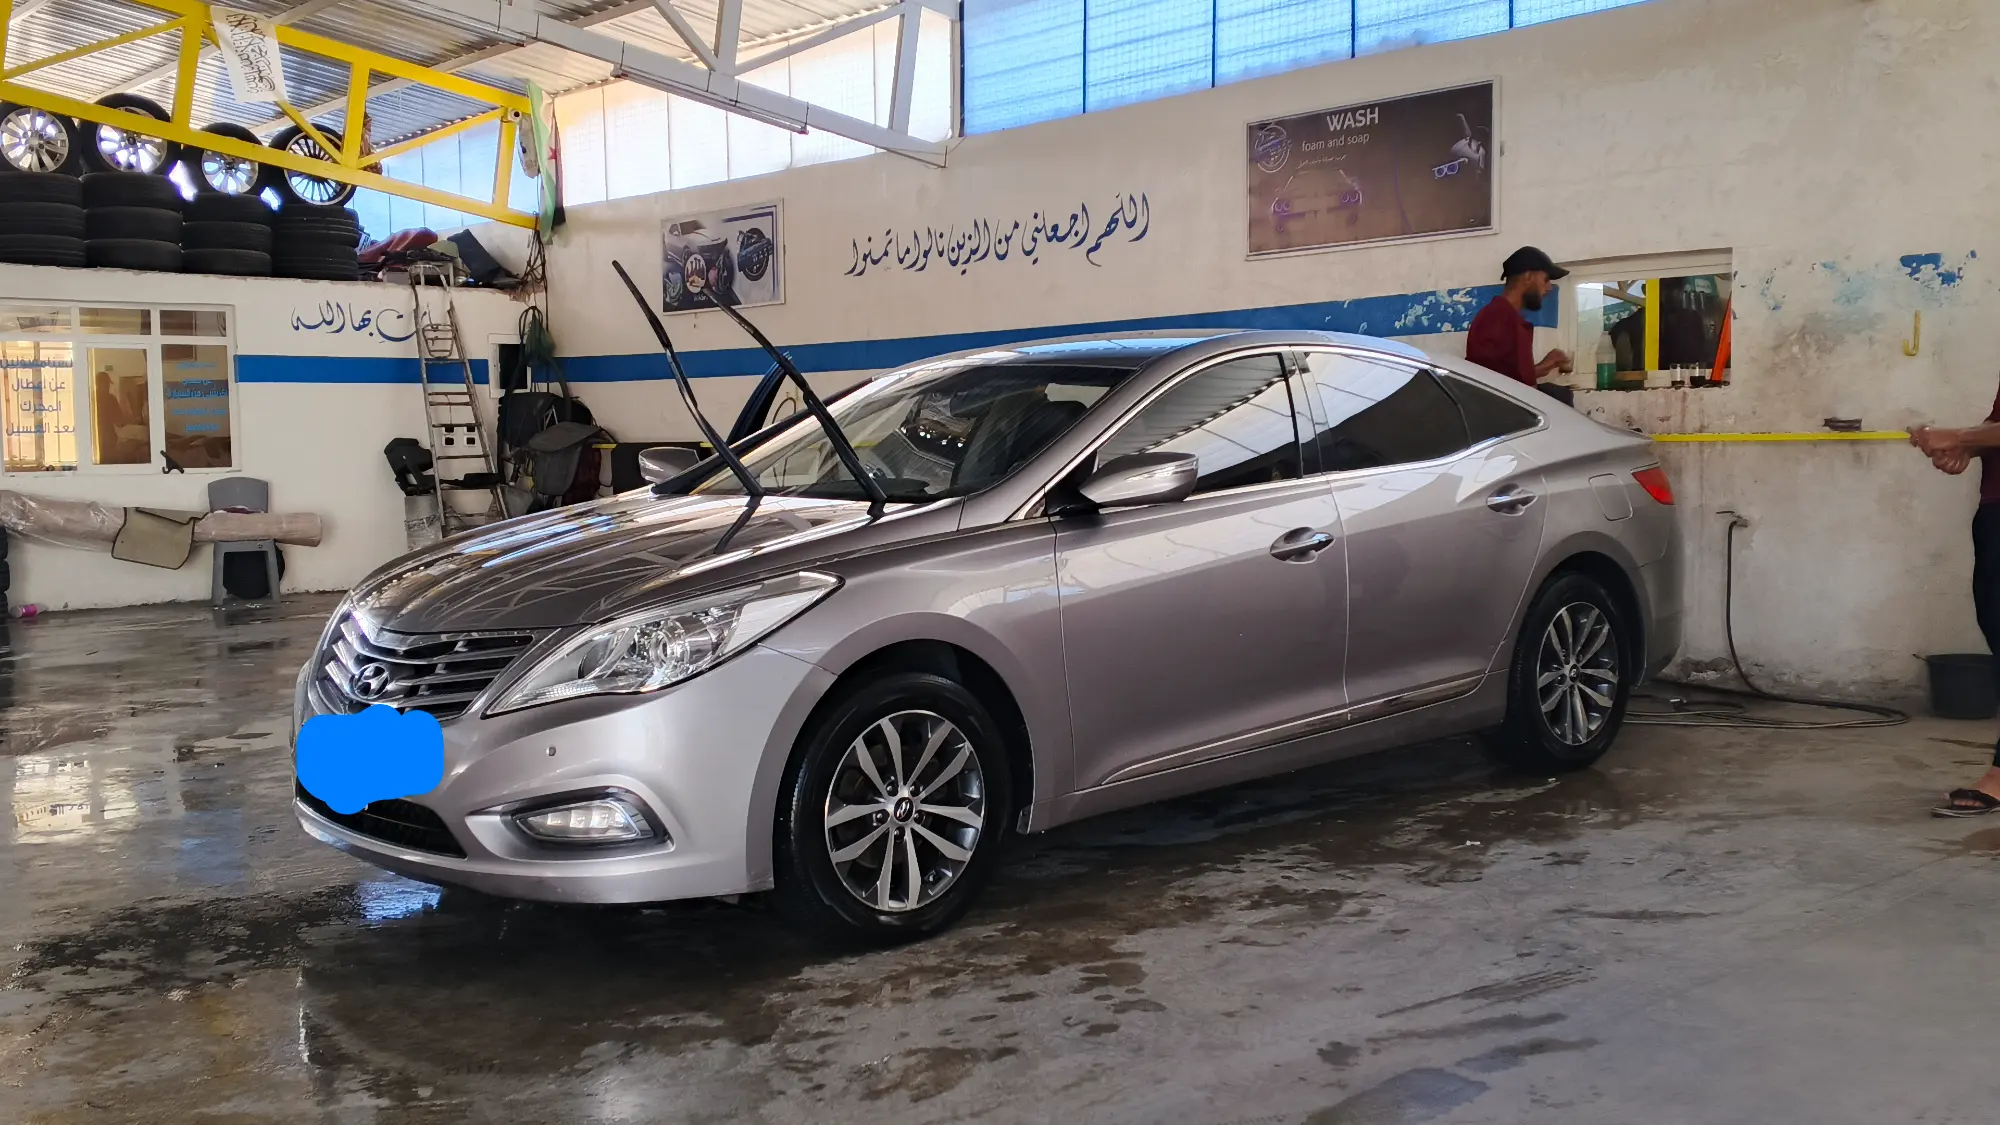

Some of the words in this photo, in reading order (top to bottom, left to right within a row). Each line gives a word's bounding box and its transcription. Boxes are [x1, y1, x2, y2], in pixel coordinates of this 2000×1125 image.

[1327, 106, 1379, 132] WASH
[1302, 140, 1325, 153] foam
[1327, 135, 1345, 149] and
[1347, 132, 1370, 147] soap
[844, 228, 893, 276] تمنوا
[896, 231, 911, 265] ما
[903, 225, 945, 272] نالوا
[947, 217, 991, 276] الذين
[994, 218, 1020, 261] من
[1021, 201, 1090, 266] اجعلني
[291, 299, 346, 334] الله
[49, 377, 66, 392] عن
